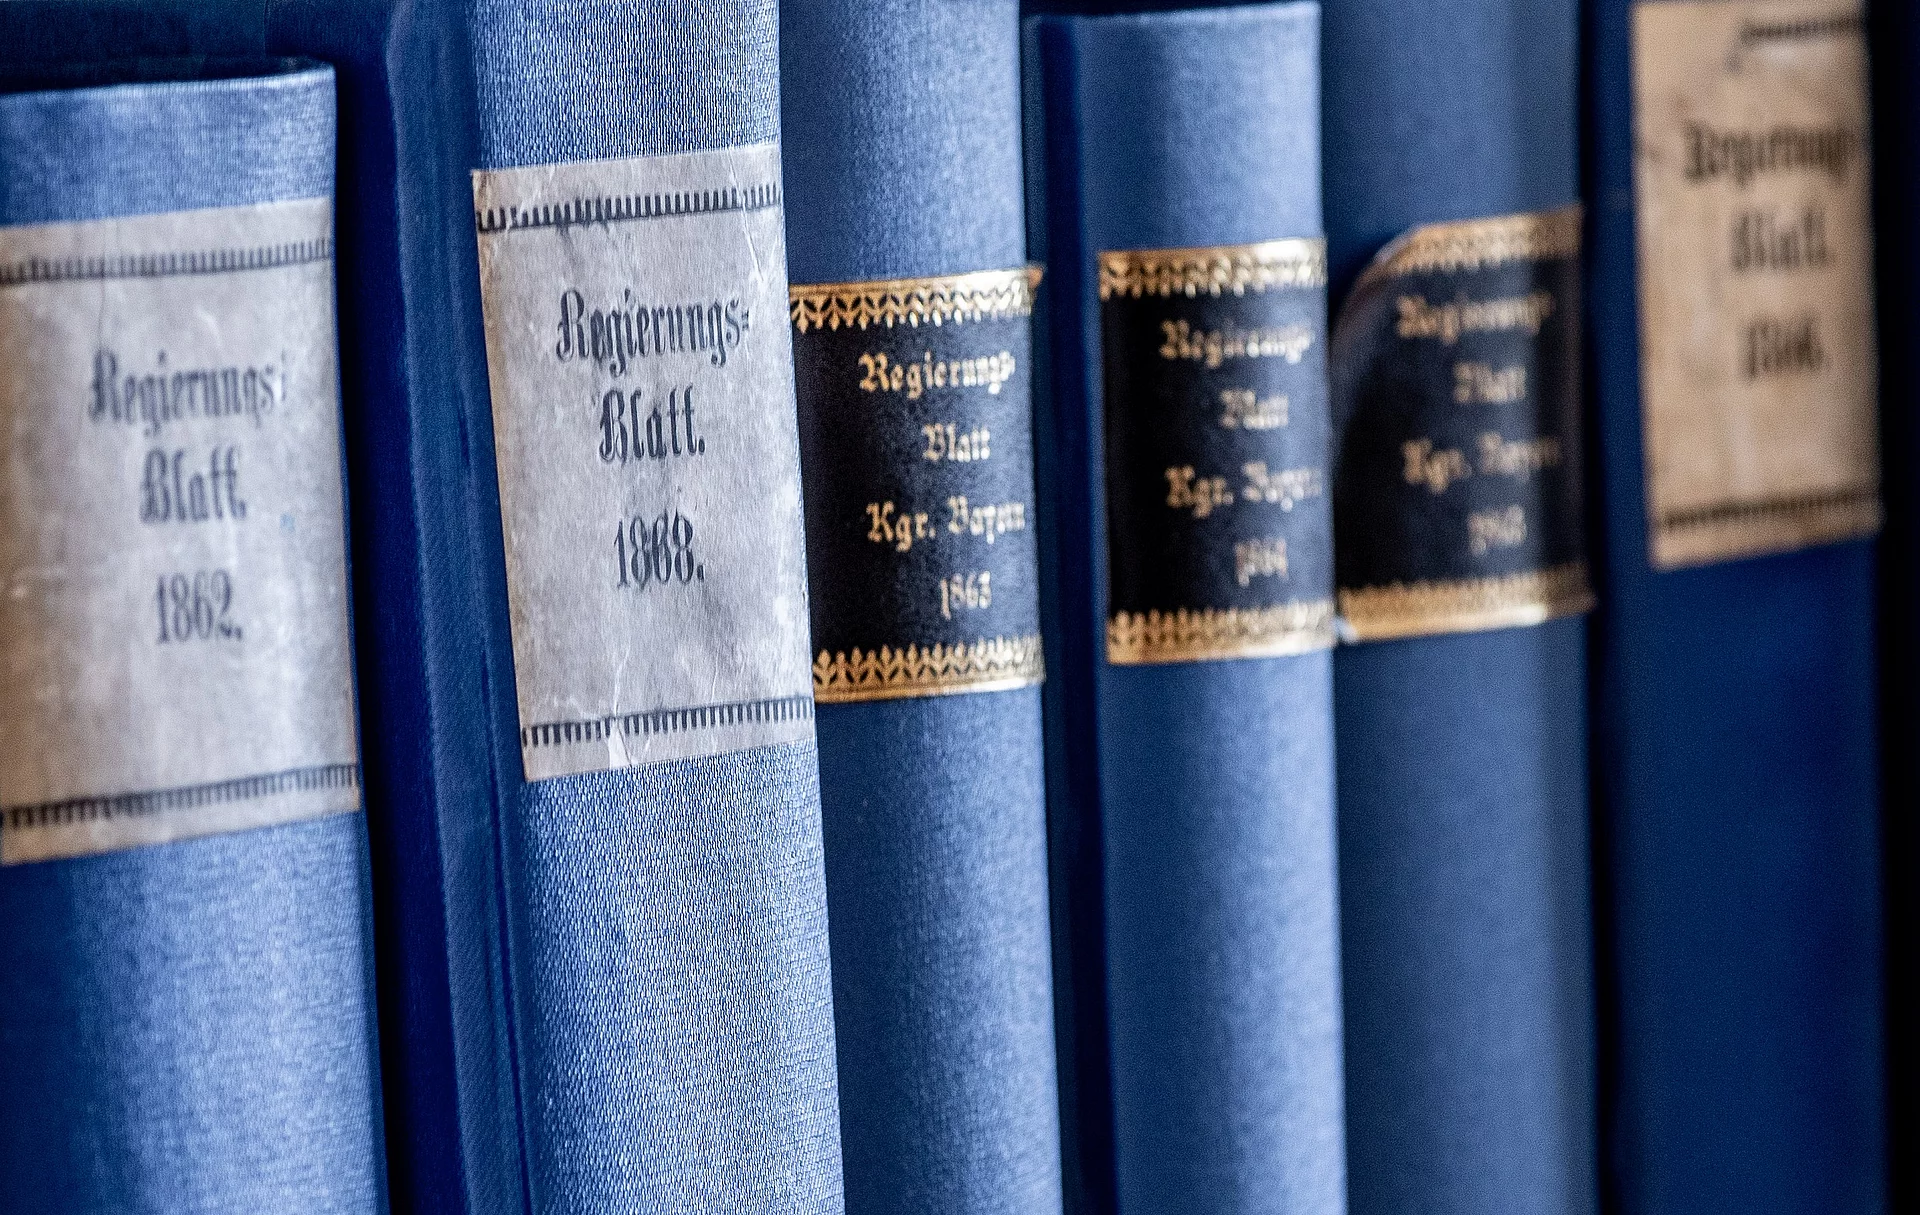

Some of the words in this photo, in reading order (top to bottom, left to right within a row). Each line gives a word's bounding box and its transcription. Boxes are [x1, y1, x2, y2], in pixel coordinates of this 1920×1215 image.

[599, 382, 706, 464] Blatt.
[613, 508, 705, 590] 1868.
[866, 500, 937, 552] Kgr.
[156, 568, 244, 645] 1862.
